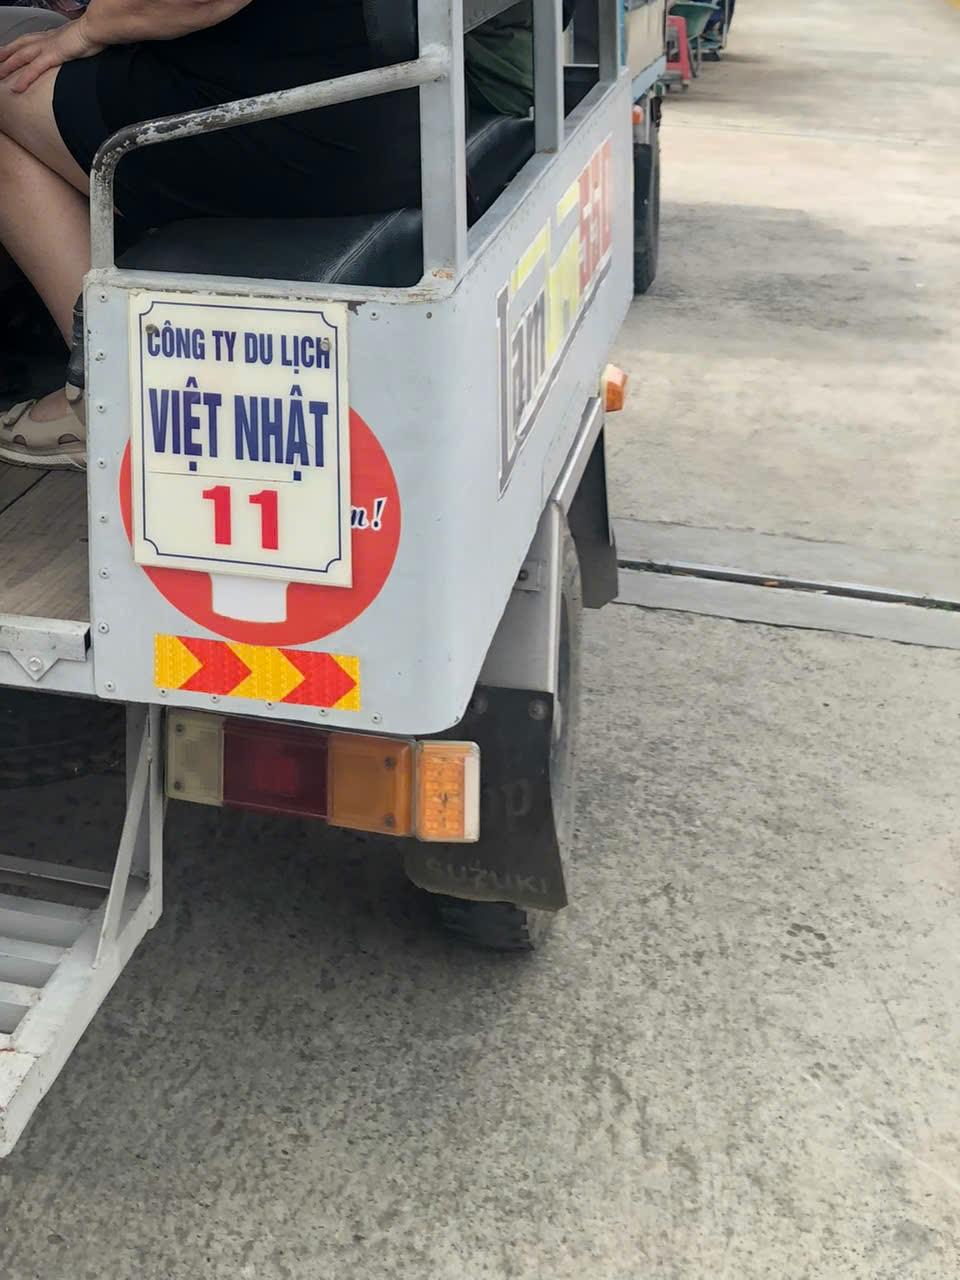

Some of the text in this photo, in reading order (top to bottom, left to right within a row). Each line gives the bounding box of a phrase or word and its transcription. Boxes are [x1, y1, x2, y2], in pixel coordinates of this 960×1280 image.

[147, 320, 331, 375] CÔNG TY DU LỊCH
[148, 376, 330, 482] VIỆT NHẬT
[202, 485, 280, 551] 11
[351, 497, 387, 529] n!
